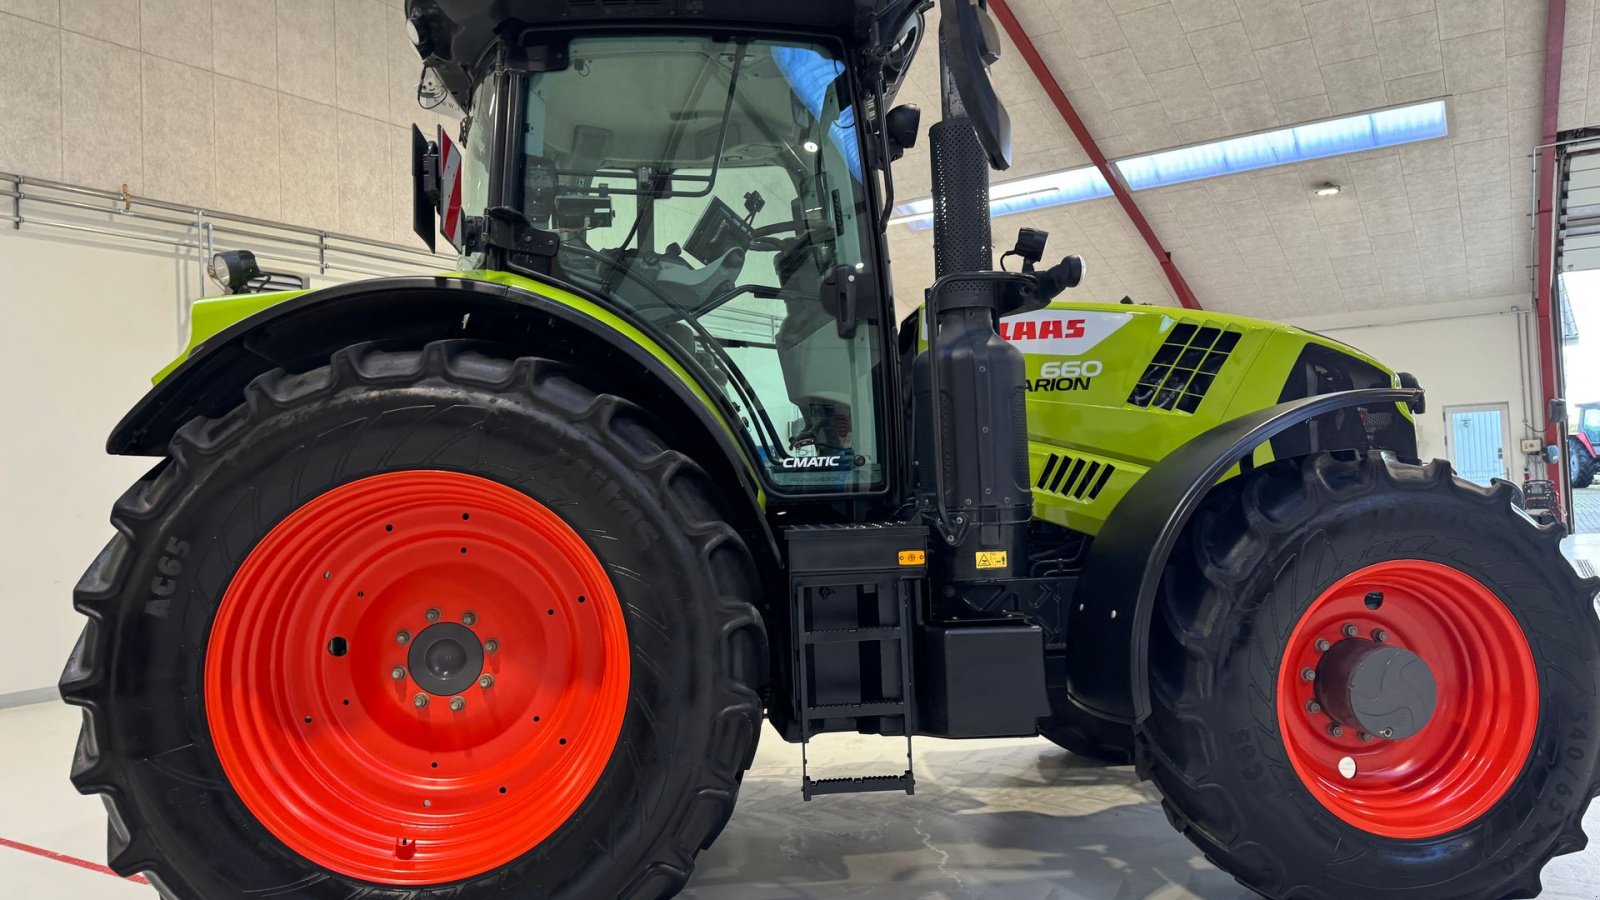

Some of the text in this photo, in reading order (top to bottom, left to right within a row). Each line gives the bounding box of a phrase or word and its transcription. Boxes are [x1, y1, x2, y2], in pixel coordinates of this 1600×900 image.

[1000, 319, 1086, 341] LAAS
[1040, 360, 1103, 379] 660
[782, 455, 841, 468] CMATIC
[144, 536, 191, 619] AC65
